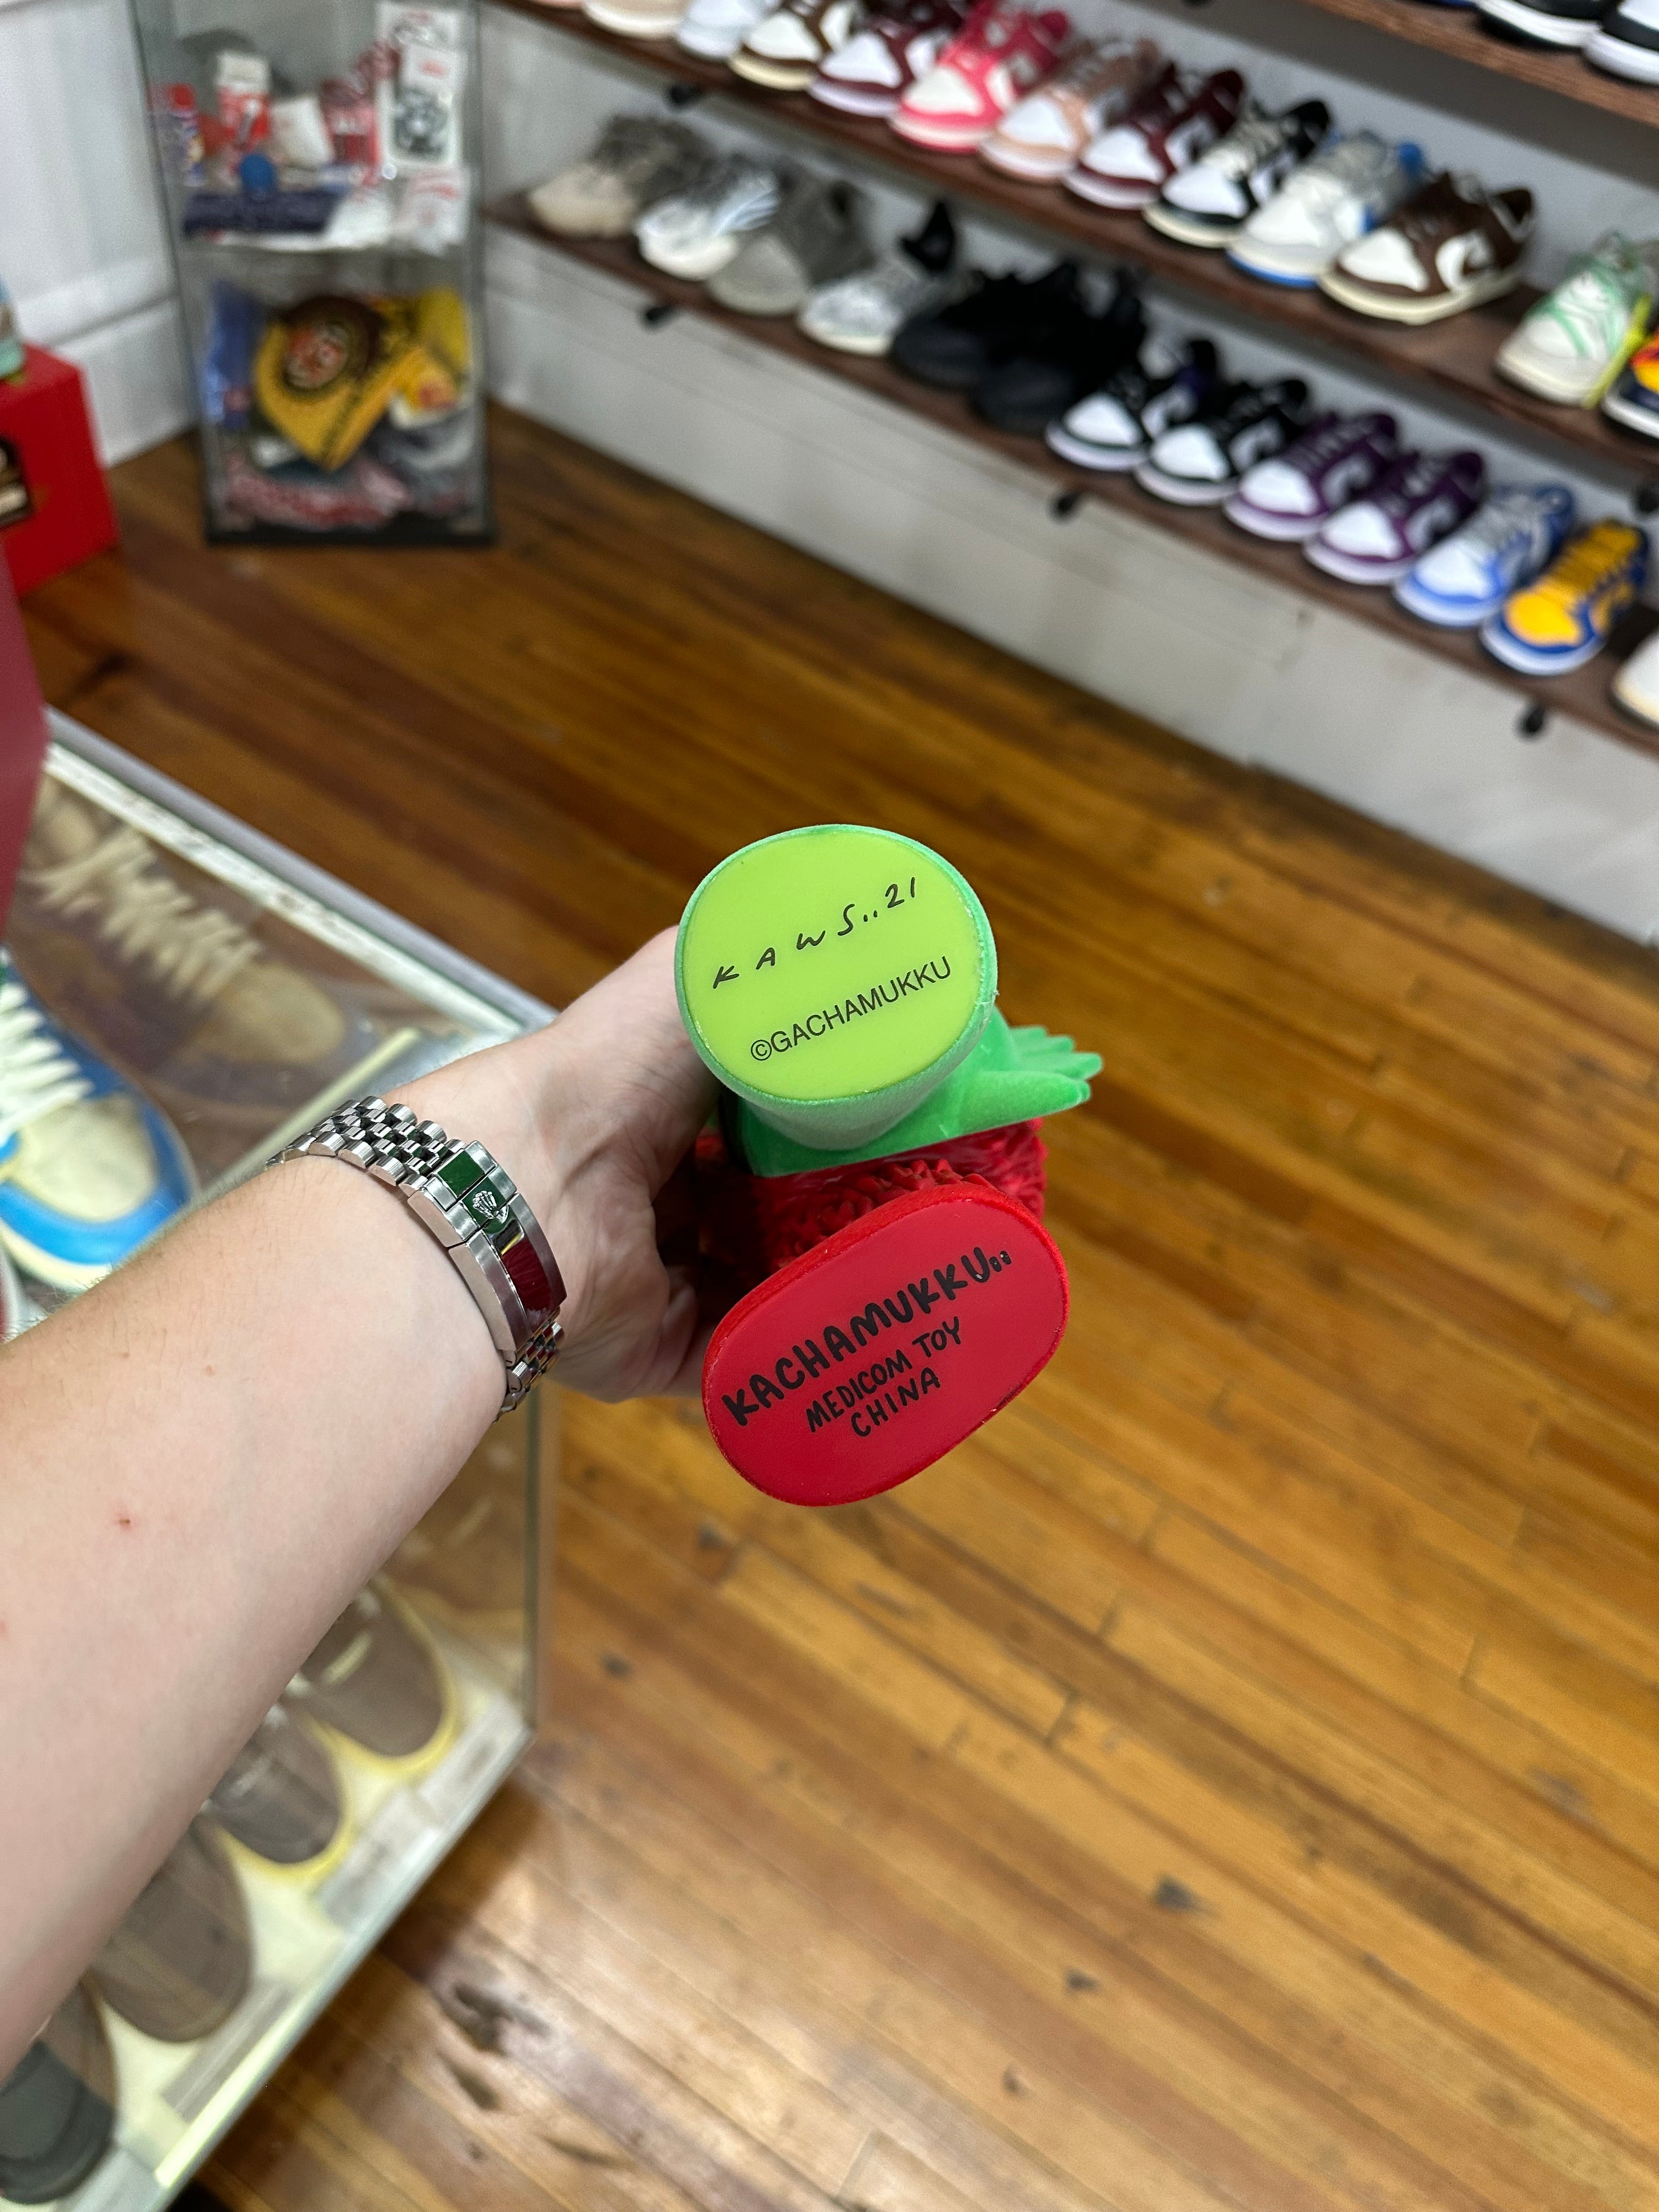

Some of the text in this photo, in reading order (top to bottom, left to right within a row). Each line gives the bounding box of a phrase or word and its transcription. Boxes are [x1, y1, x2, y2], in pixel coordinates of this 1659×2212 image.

[751, 956, 951, 1061] ©GACHAMUKKU
[805, 1316, 961, 1433] MEDICOM TOY
[850, 1367, 941, 1437] CHINA
